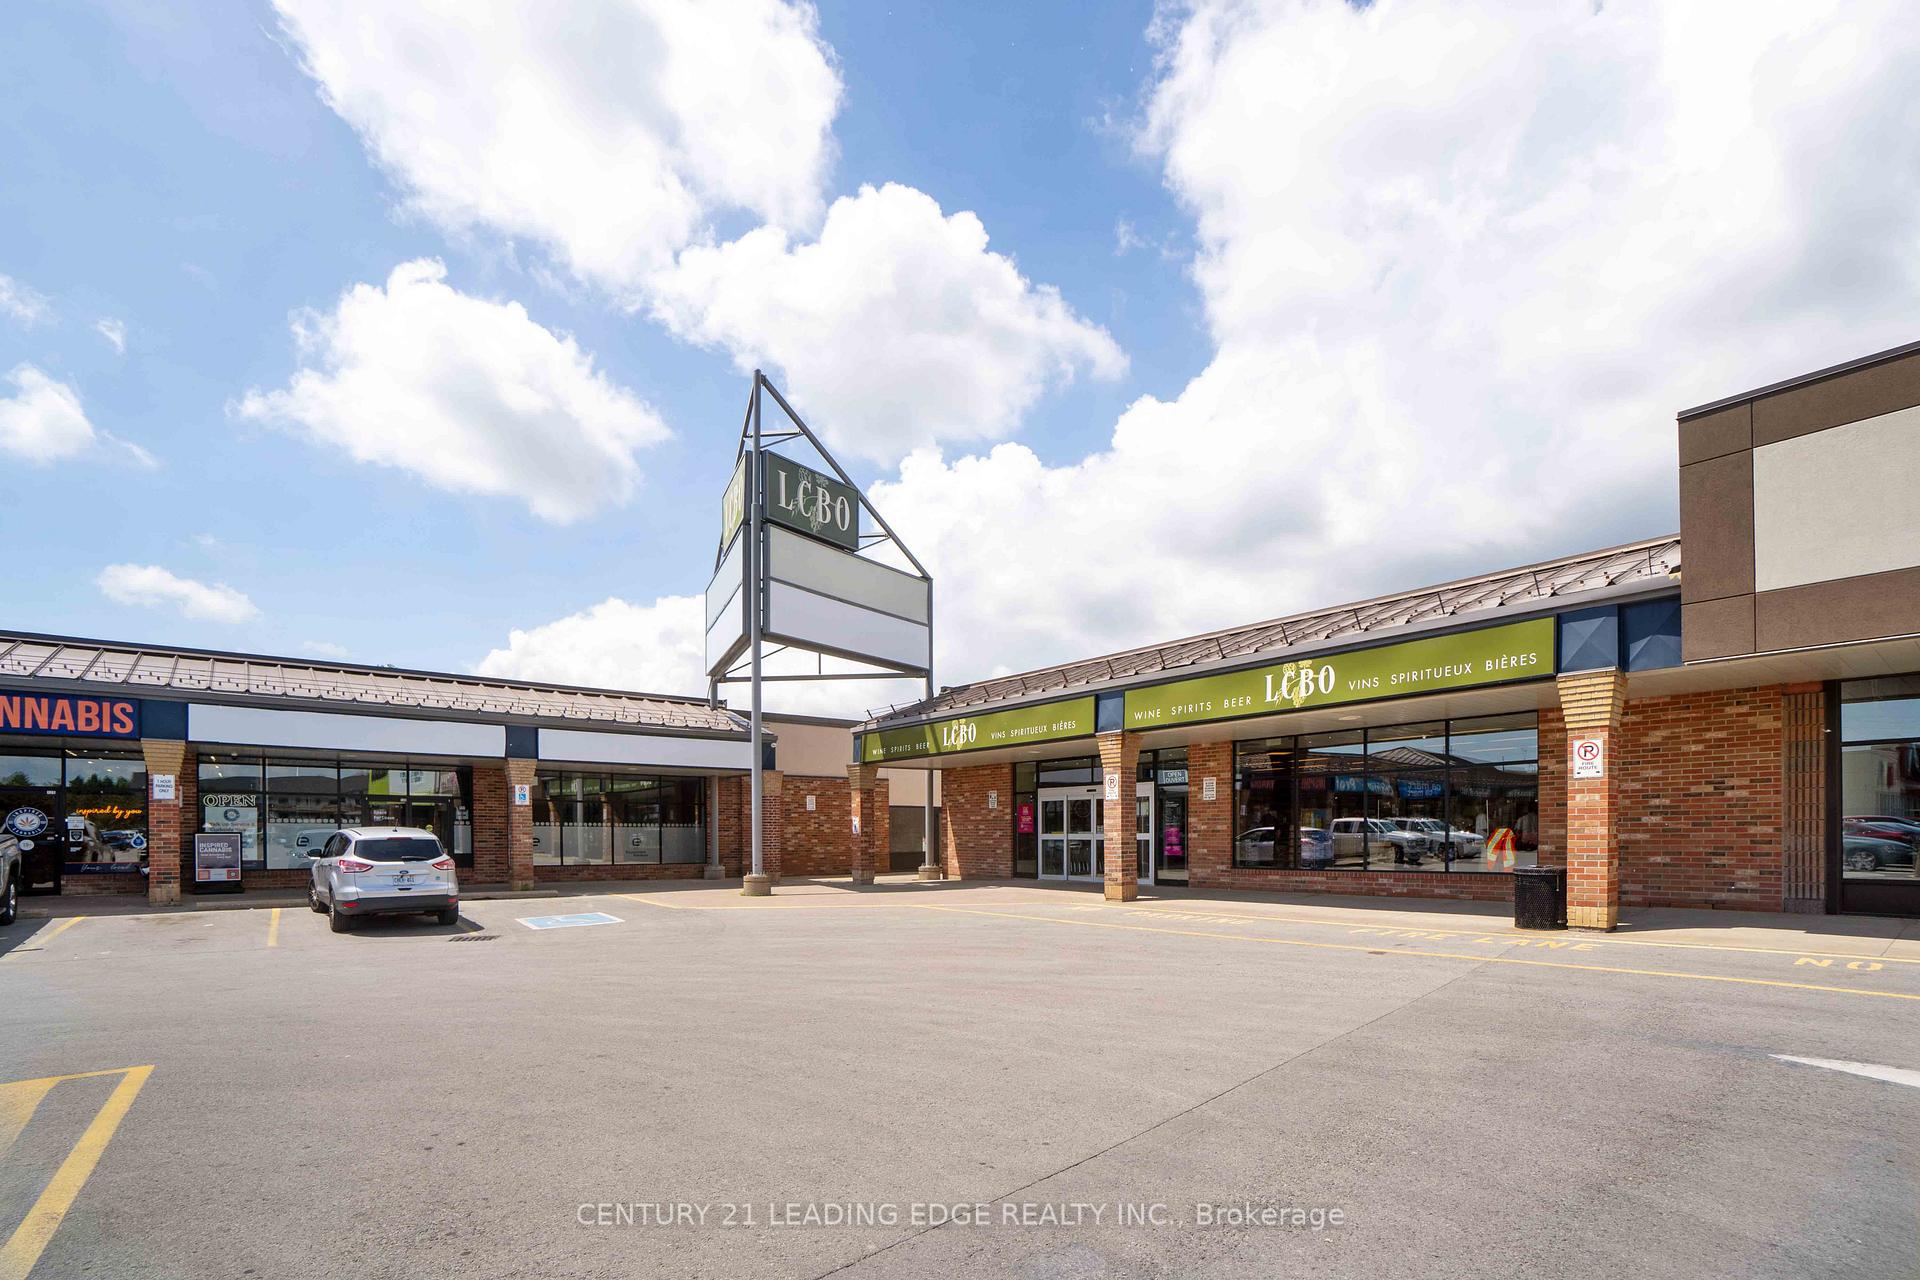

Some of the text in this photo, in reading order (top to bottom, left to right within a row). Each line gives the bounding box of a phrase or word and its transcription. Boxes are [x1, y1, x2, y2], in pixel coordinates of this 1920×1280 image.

[777, 470, 850, 531] LCBO
[1134, 652, 1537, 720] WINE SPIRITS BEER LCBO VINS SPIRITUEUX BIÈRES
[872, 720, 1076, 755] WINE SPIRITS BEER LCBO VINS SPIRITUEUX BIÈRES
[203, 794, 256, 807] OPEN
[76, 805, 142, 819] inspired by you
[1472, 936, 1604, 951] LANE
[1793, 957, 1884, 971] NO
